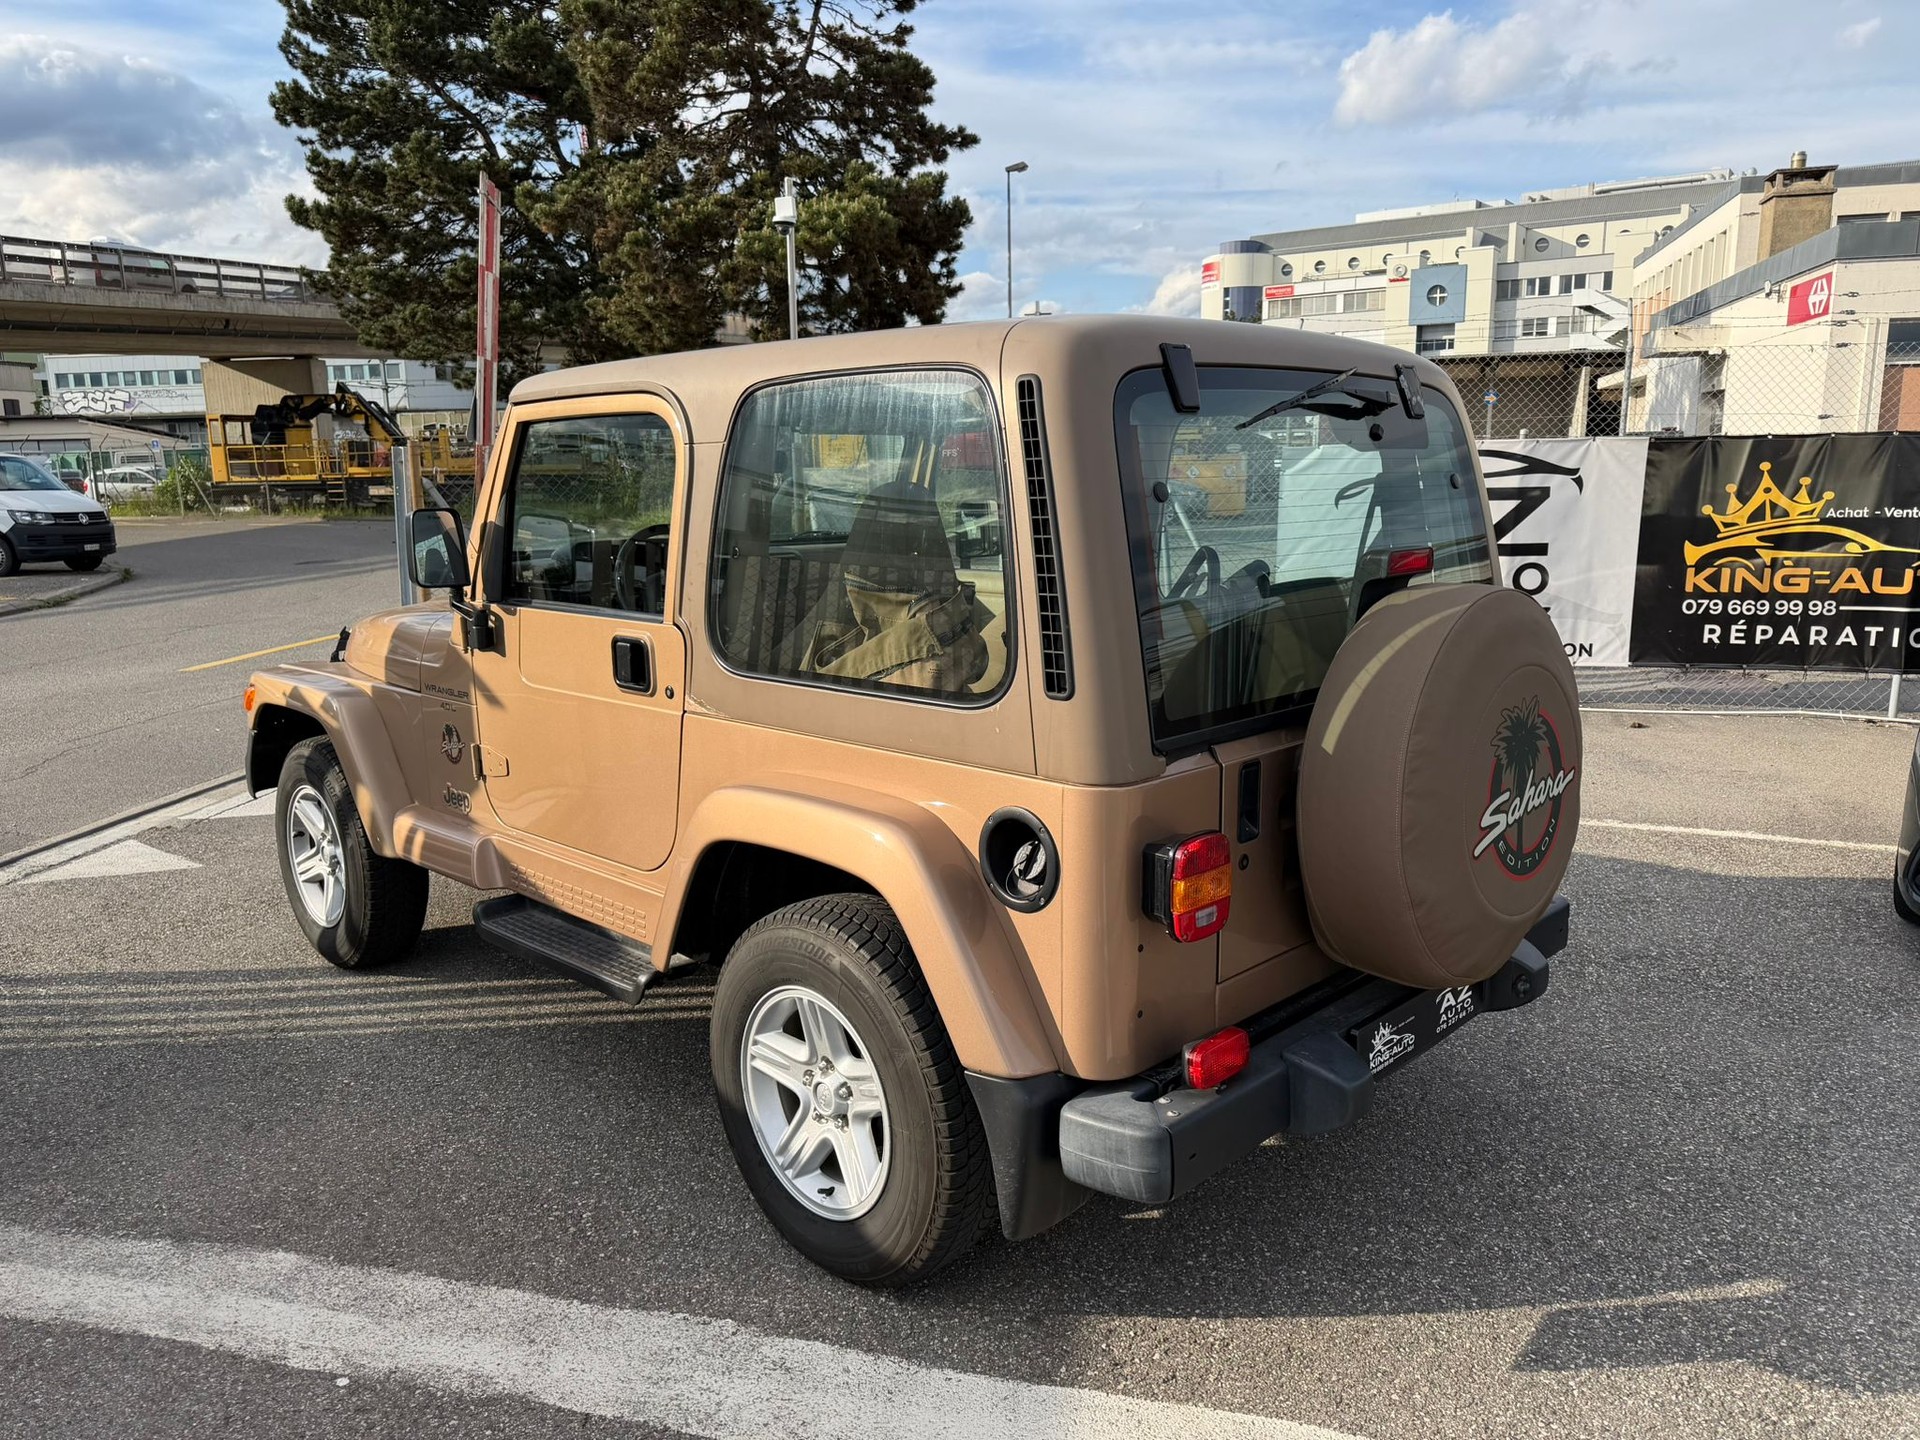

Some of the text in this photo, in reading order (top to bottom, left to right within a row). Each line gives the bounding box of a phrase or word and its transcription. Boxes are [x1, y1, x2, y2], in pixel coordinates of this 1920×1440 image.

[1826, 507, 1869, 518] Achat
[1884, 506, 1920, 518] Vent
[1685, 566, 1920, 593] KING-AU
[1681, 599, 1837, 616] 079 669 99 98
[424, 682, 469, 699] WRANGLER
[444, 783, 471, 815] Jeep
[1473, 767, 1575, 858] Sahara
[1498, 818, 1556, 870] EDITION
[1440, 985, 1472, 1014] AZ
[1440, 998, 1472, 1024] AUTO
[1370, 1035, 1415, 1070] KING-AUTO
